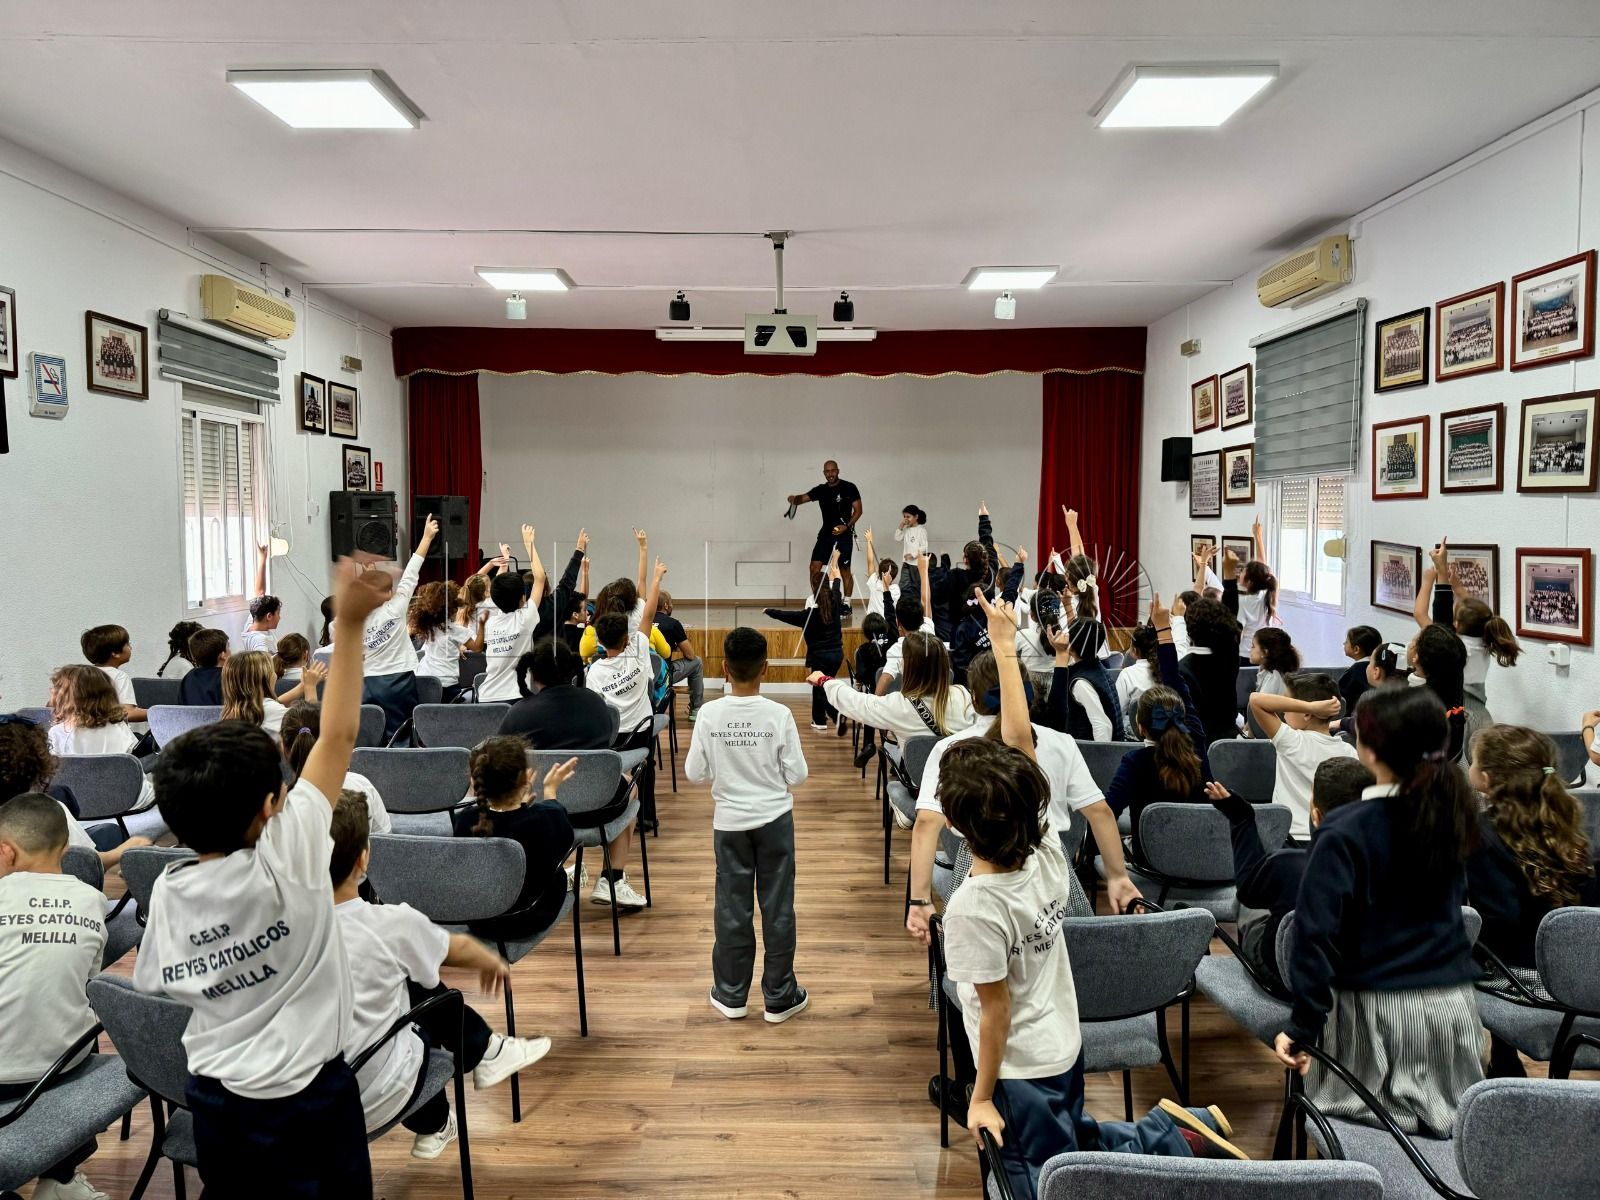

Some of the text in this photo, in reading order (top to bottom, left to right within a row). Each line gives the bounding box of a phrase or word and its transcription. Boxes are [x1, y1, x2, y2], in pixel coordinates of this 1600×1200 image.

[615, 681, 638, 697] MELILLA
[28, 897, 72, 909] C.E.I.P.
[0, 911, 102, 933] EYES CATÓLICOS
[22, 931, 78, 945] MELILLA
[162, 920, 291, 985] REYES CATÓLICOS
[201, 963, 279, 1001] MELILLA
